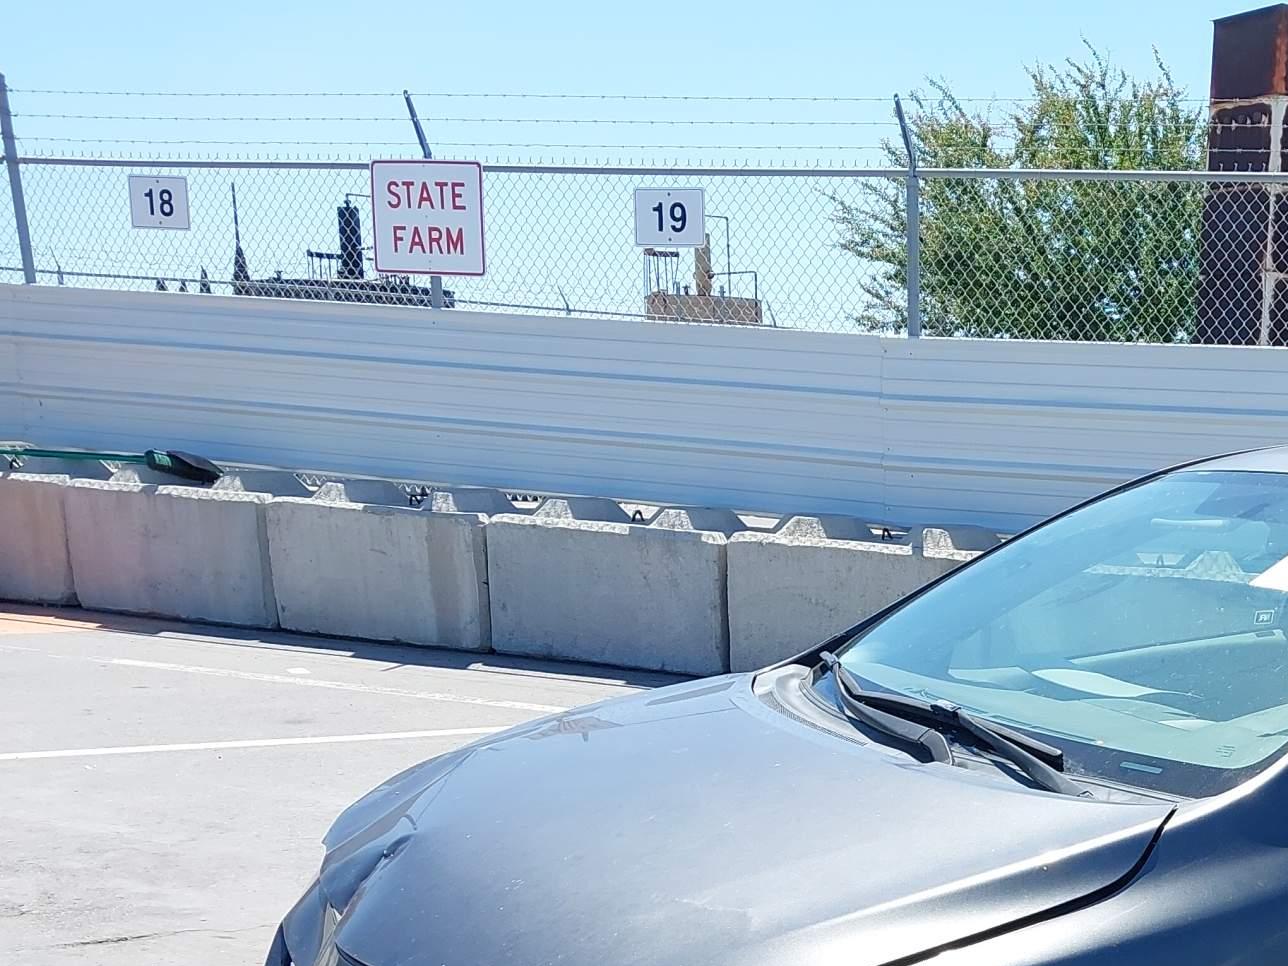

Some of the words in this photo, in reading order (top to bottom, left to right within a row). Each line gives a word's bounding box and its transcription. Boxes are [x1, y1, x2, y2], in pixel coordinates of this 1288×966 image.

[143, 188, 174, 217] 18
[386, 180, 467, 212] STATE
[652, 201, 687, 233] 19
[391, 225, 466, 257] FARM
